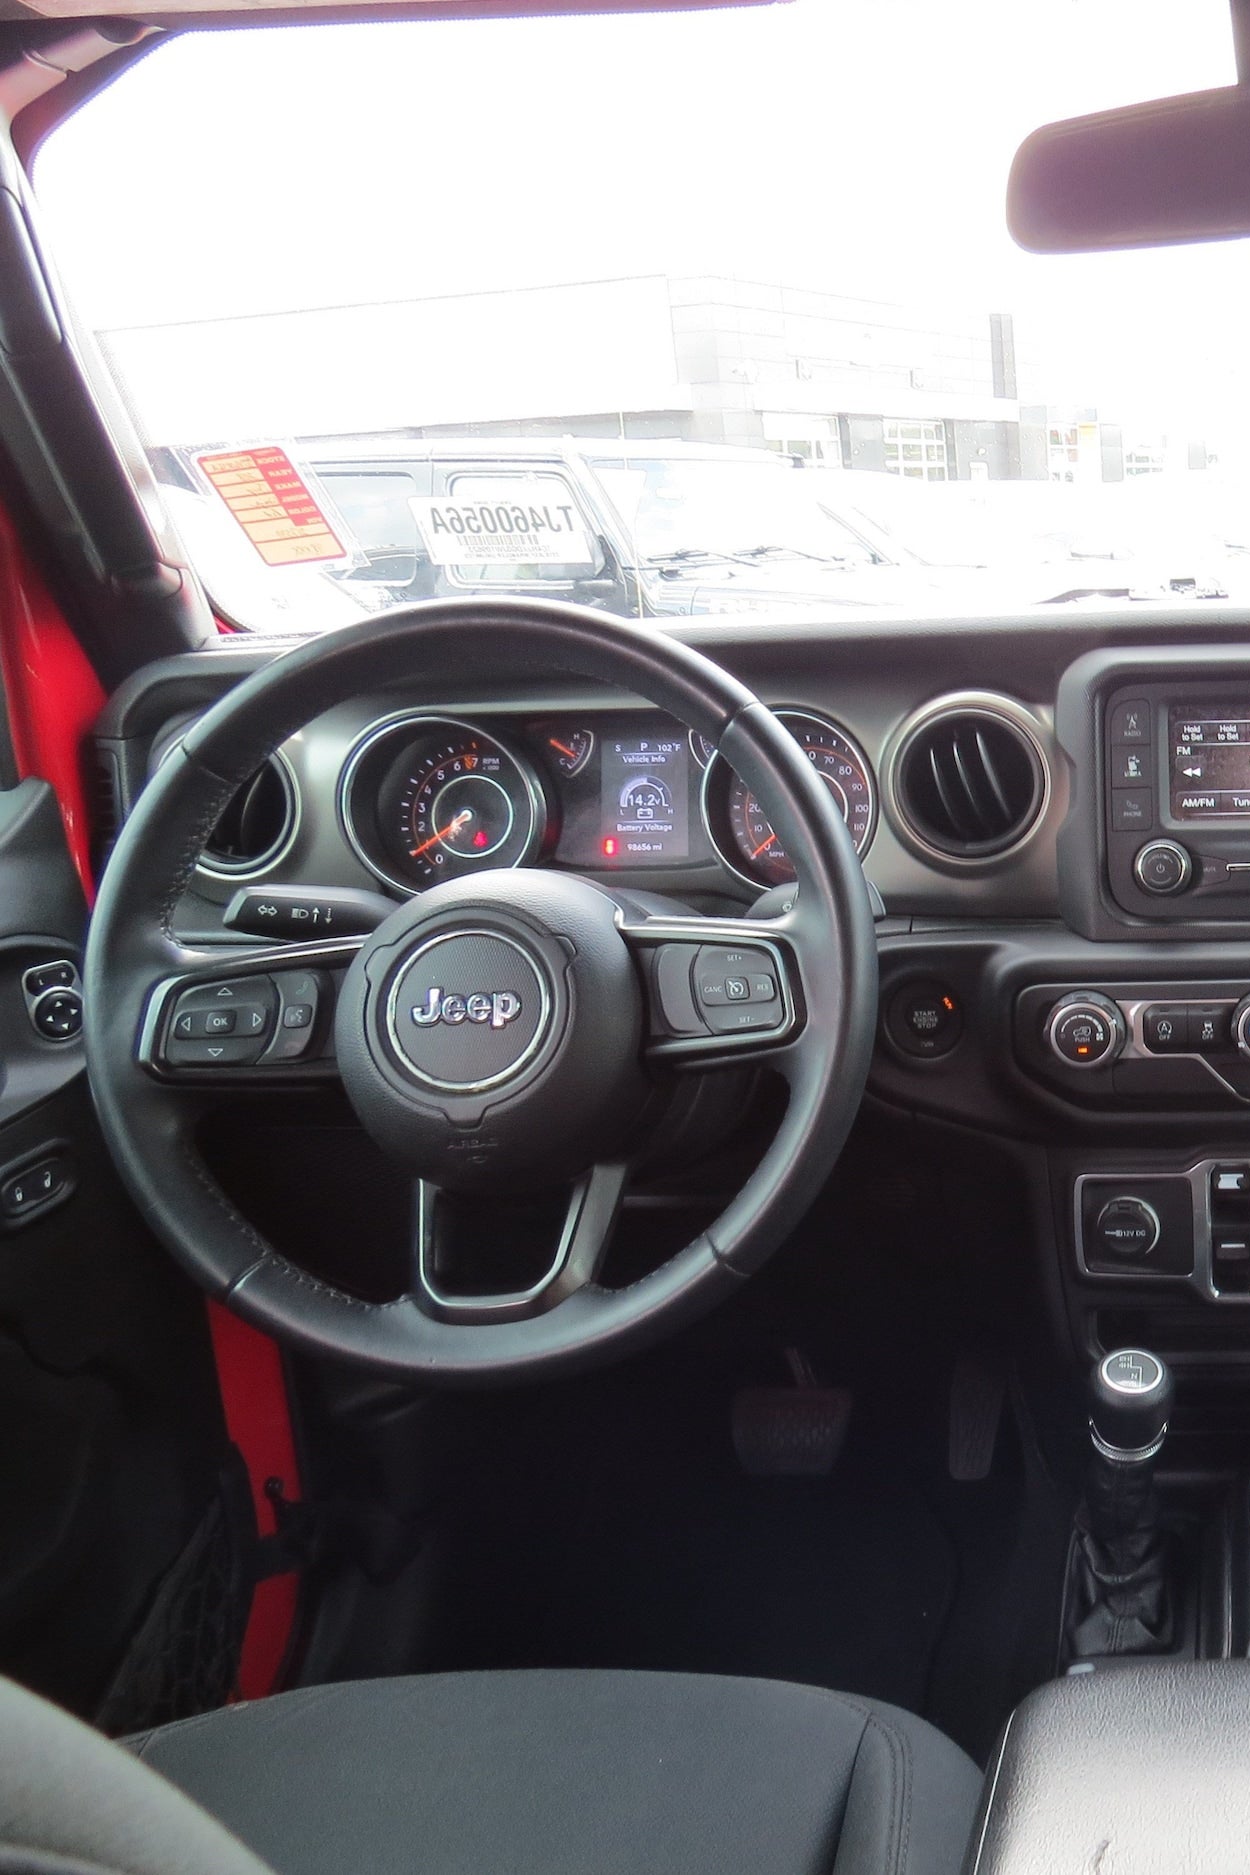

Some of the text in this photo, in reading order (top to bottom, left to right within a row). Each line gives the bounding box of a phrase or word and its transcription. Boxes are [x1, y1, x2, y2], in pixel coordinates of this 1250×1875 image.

[1183, 725, 1201, 733] Hold
[1219, 724, 1237, 733] Hold
[1182, 733, 1203, 741] to Set
[1217, 732, 1239, 741] to Set
[640, 743, 648, 752] P
[1176, 747, 1191, 756] FM
[472, 757, 479, 768] 7
[651, 755, 666, 763] Info
[824, 755, 835, 765] 70
[454, 762, 461, 771] 6
[839, 766, 852, 776] 80
[437, 770, 445, 780] 5
[424, 785, 432, 794] 4
[852, 783, 863, 792] 90
[418, 802, 426, 813] 3
[1182, 798, 1215, 808] AM/FM
[855, 803, 869, 813] 100
[418, 821, 425, 832] 2
[616, 823, 673, 833] Battery Voltage
[754, 824, 763, 833] 10
[853, 822, 865, 831] 110
[435, 854, 444, 864] 0
[411, 986, 522, 1029] Jeep
[213, 1017, 228, 1027] OK
